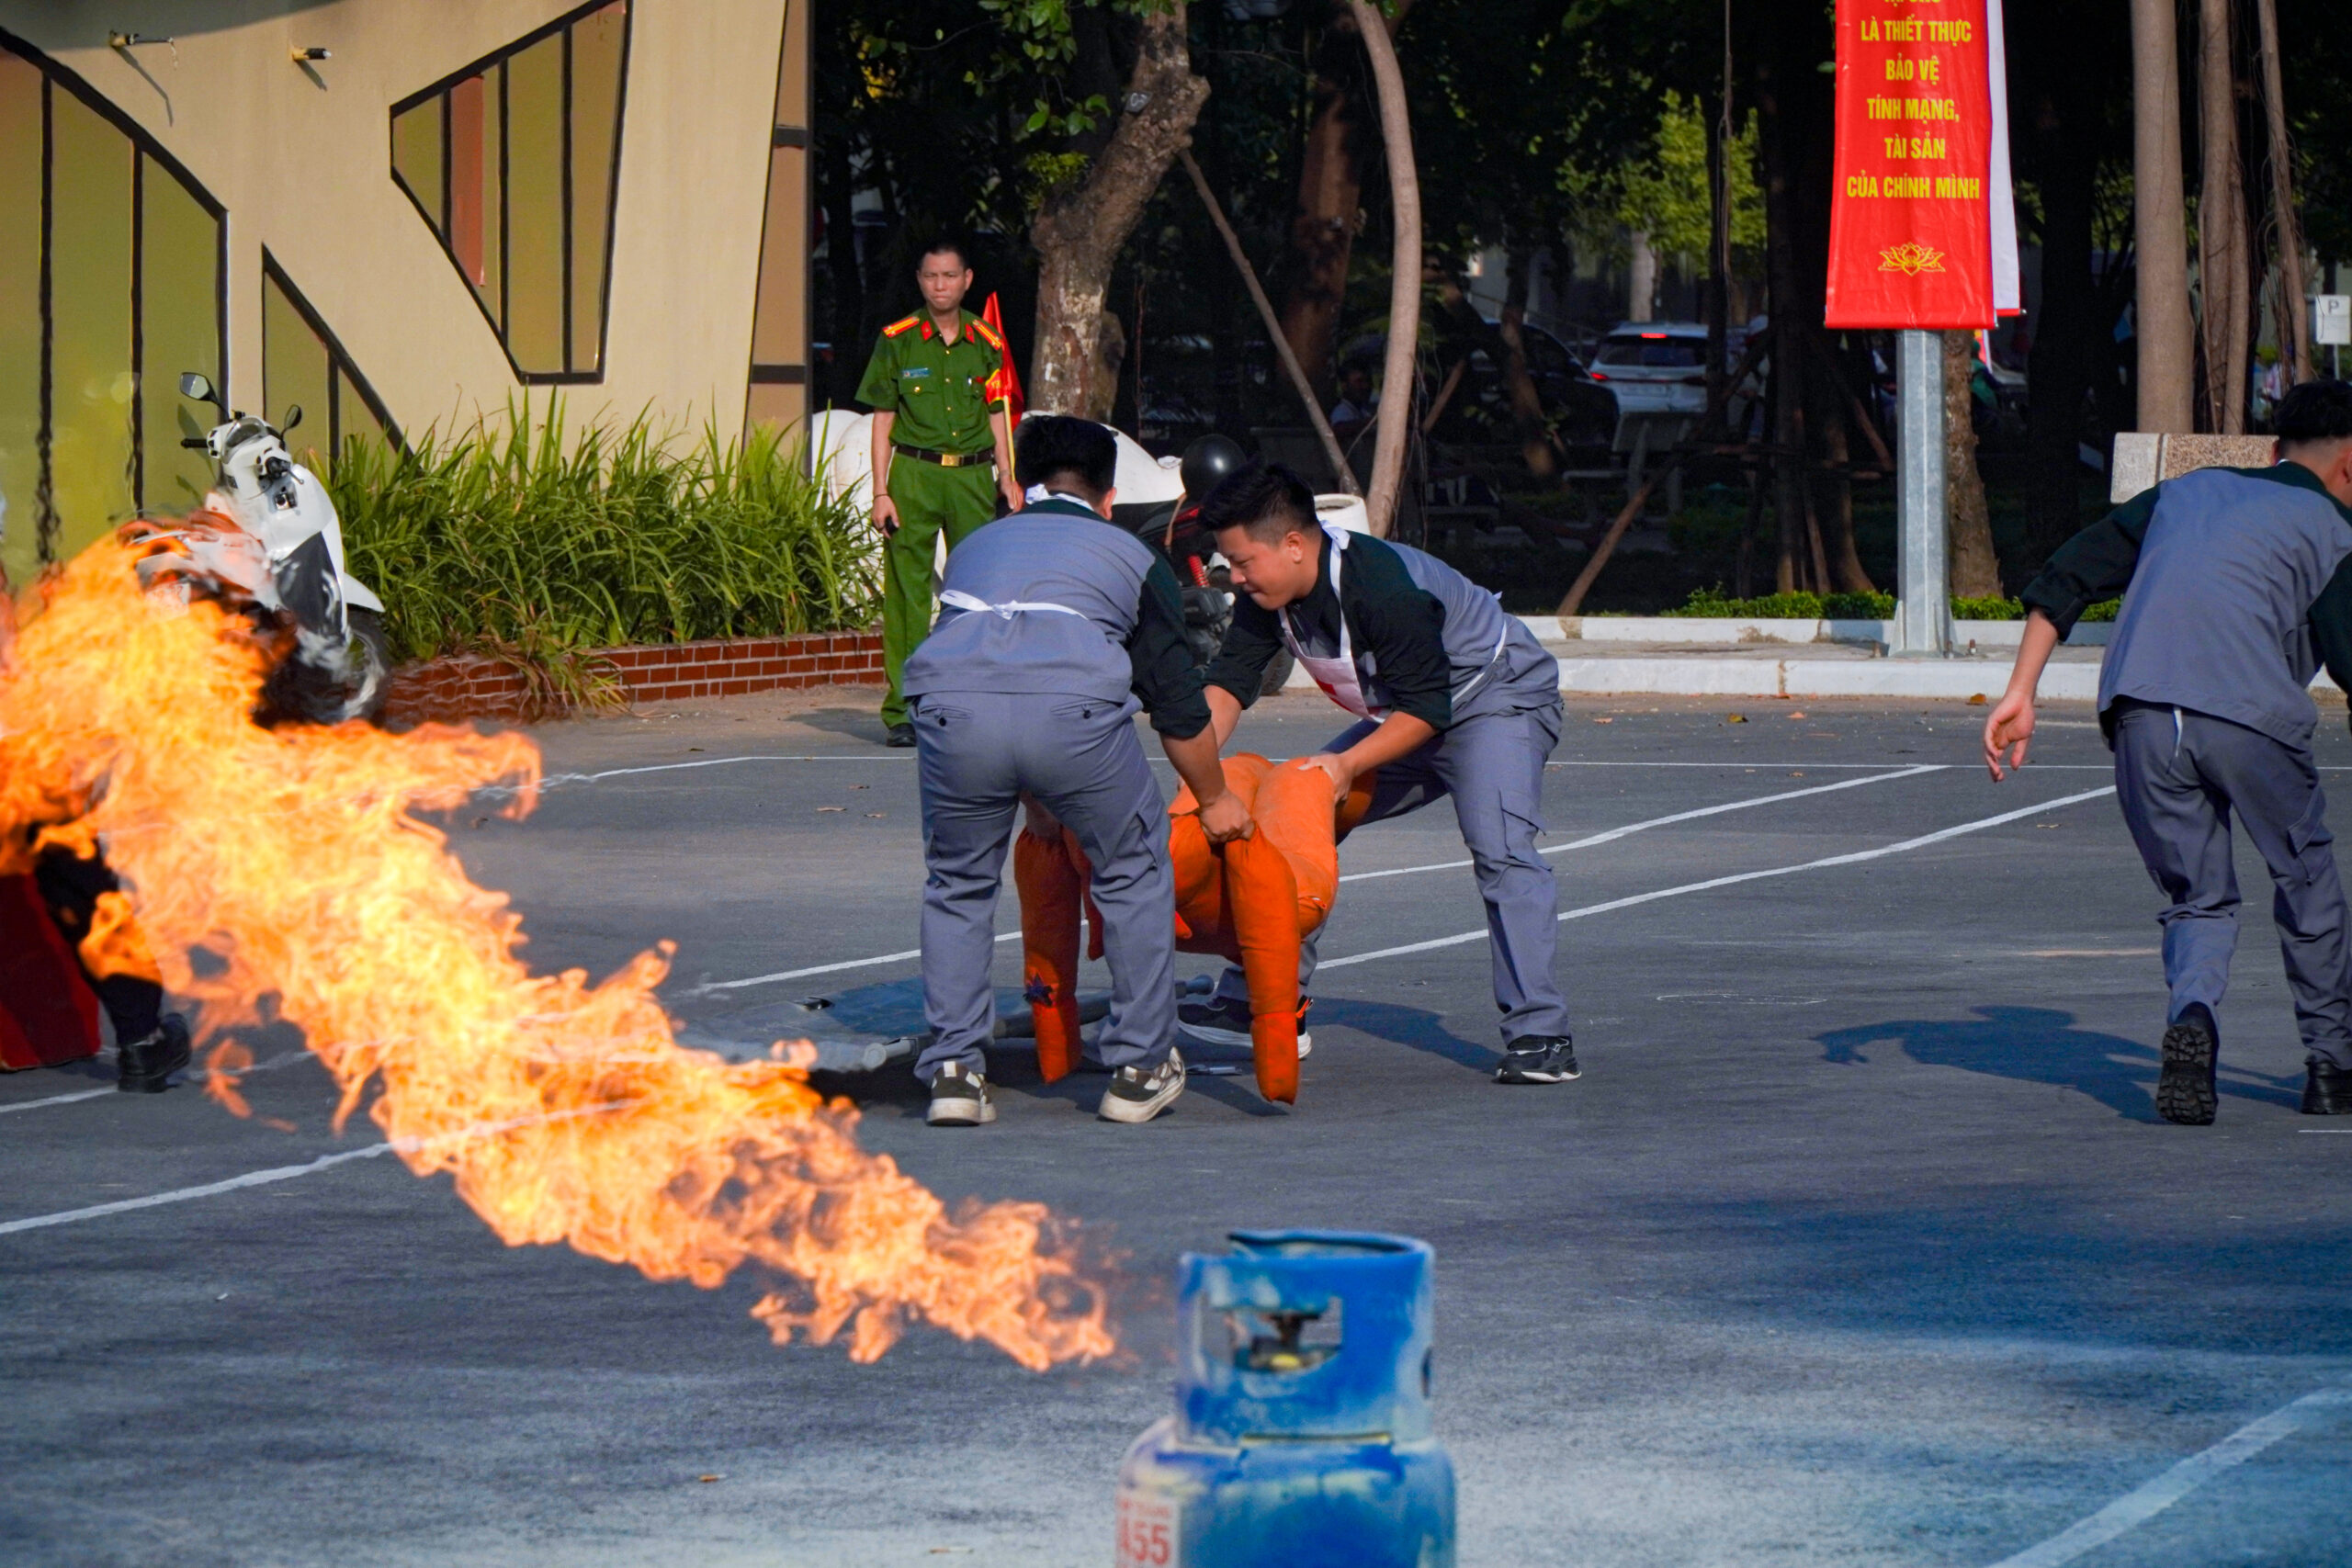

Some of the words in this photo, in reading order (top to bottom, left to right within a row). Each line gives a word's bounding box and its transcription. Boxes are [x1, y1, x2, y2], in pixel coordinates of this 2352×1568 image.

[1860, 16, 1880, 41] LÀ
[1883, 14, 1924, 41] THIẾT
[1928, 19, 1972, 47] THỰC
[1885, 52, 1914, 81] BẢO
[1918, 55, 1940, 85] VỆ
[1867, 94, 1902, 119] TÍNH
[1905, 98, 1961, 125] MẠNG,
[1884, 133, 1907, 159] TÀI
[1910, 130, 1946, 159] SẢN
[1847, 169, 1879, 198] CỦA
[1883, 172, 1930, 198] CHÍNH
[1935, 173, 1980, 199] MÌNH
[2327, 299, 2340, 314] P
